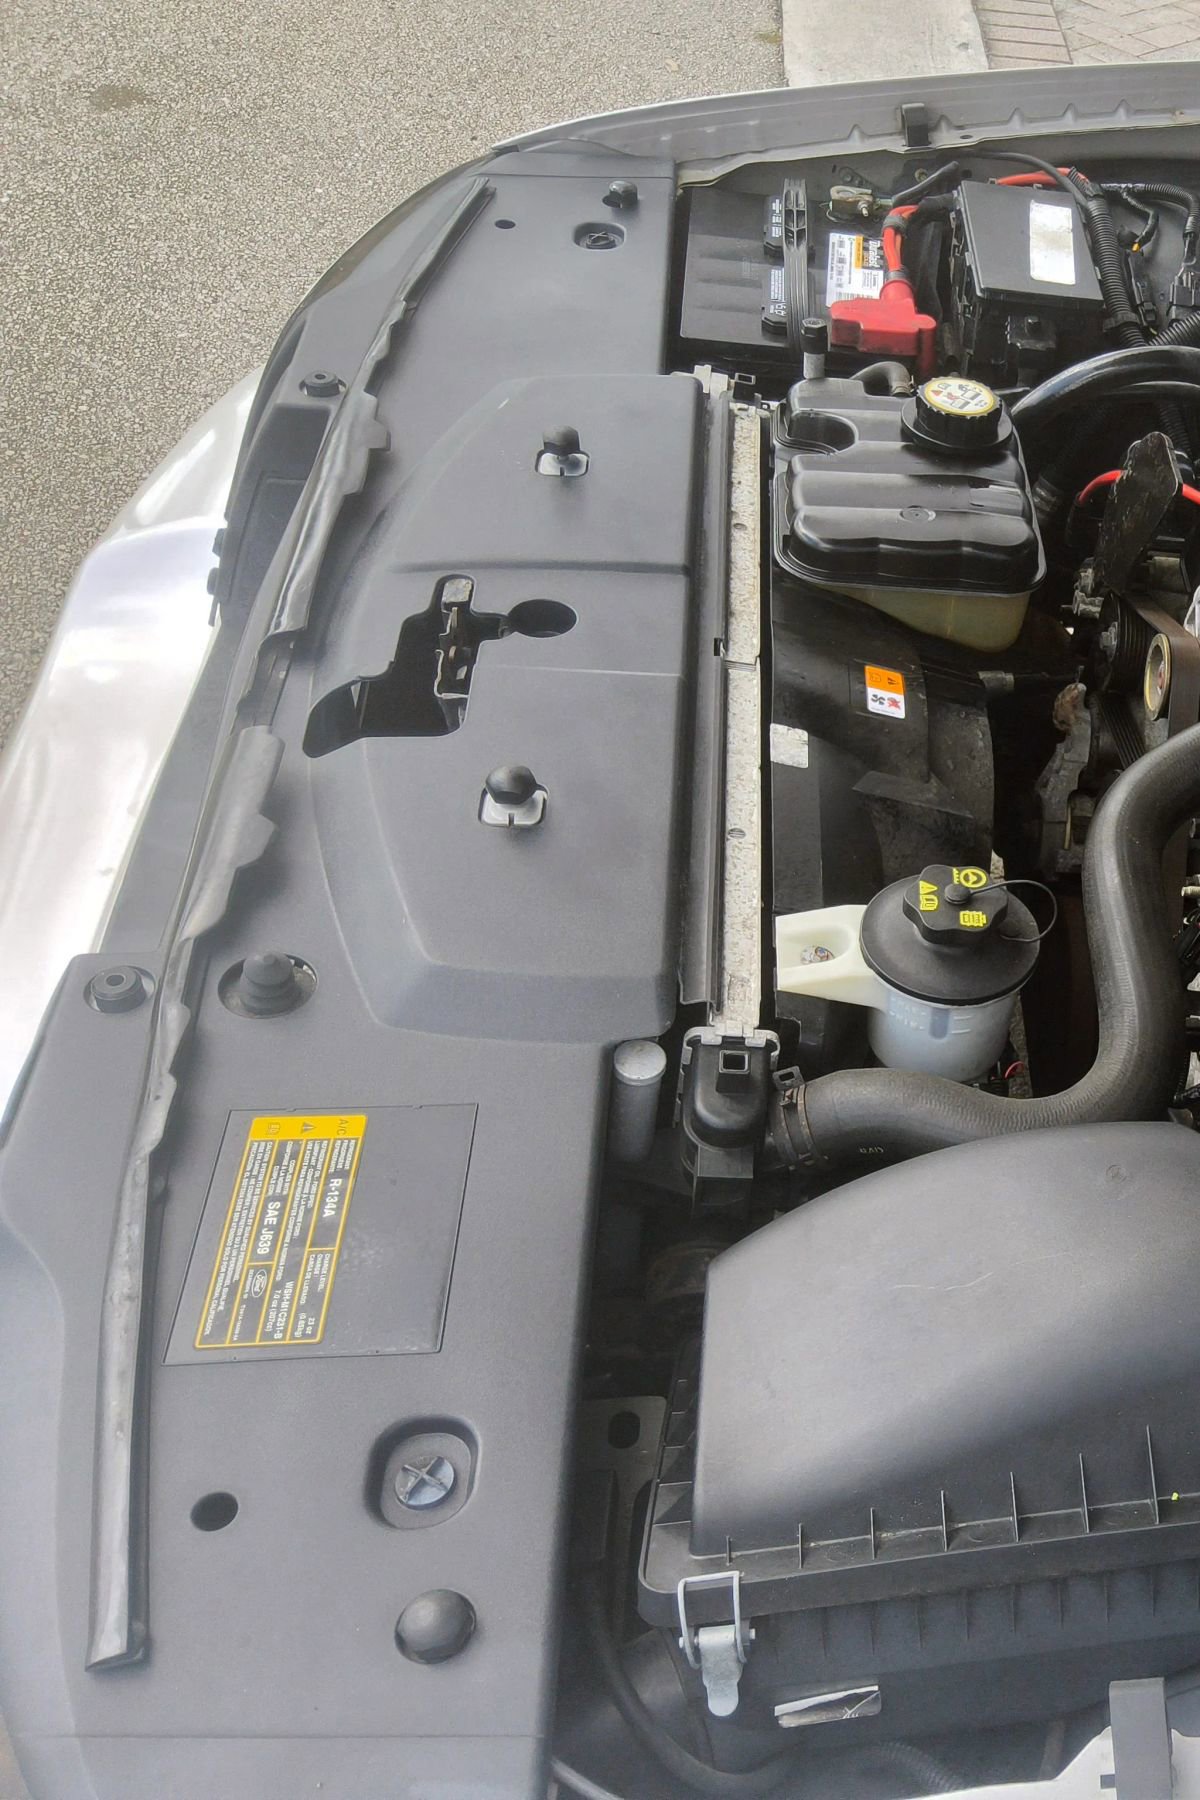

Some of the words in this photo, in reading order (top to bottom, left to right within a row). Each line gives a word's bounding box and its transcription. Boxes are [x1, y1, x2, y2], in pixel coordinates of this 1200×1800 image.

[868, 240, 881, 268] Duralast
[337, 1119, 349, 1135] A/C
[323, 1178, 342, 1217] R-134A
[264, 1201, 281, 1225] SAE
[257, 1227, 274, 1254] J639
[254, 1274, 267, 1292] Ford
[274, 1281, 294, 1339] WSH-M1C231-B
[308, 1317, 315, 1325] 23
